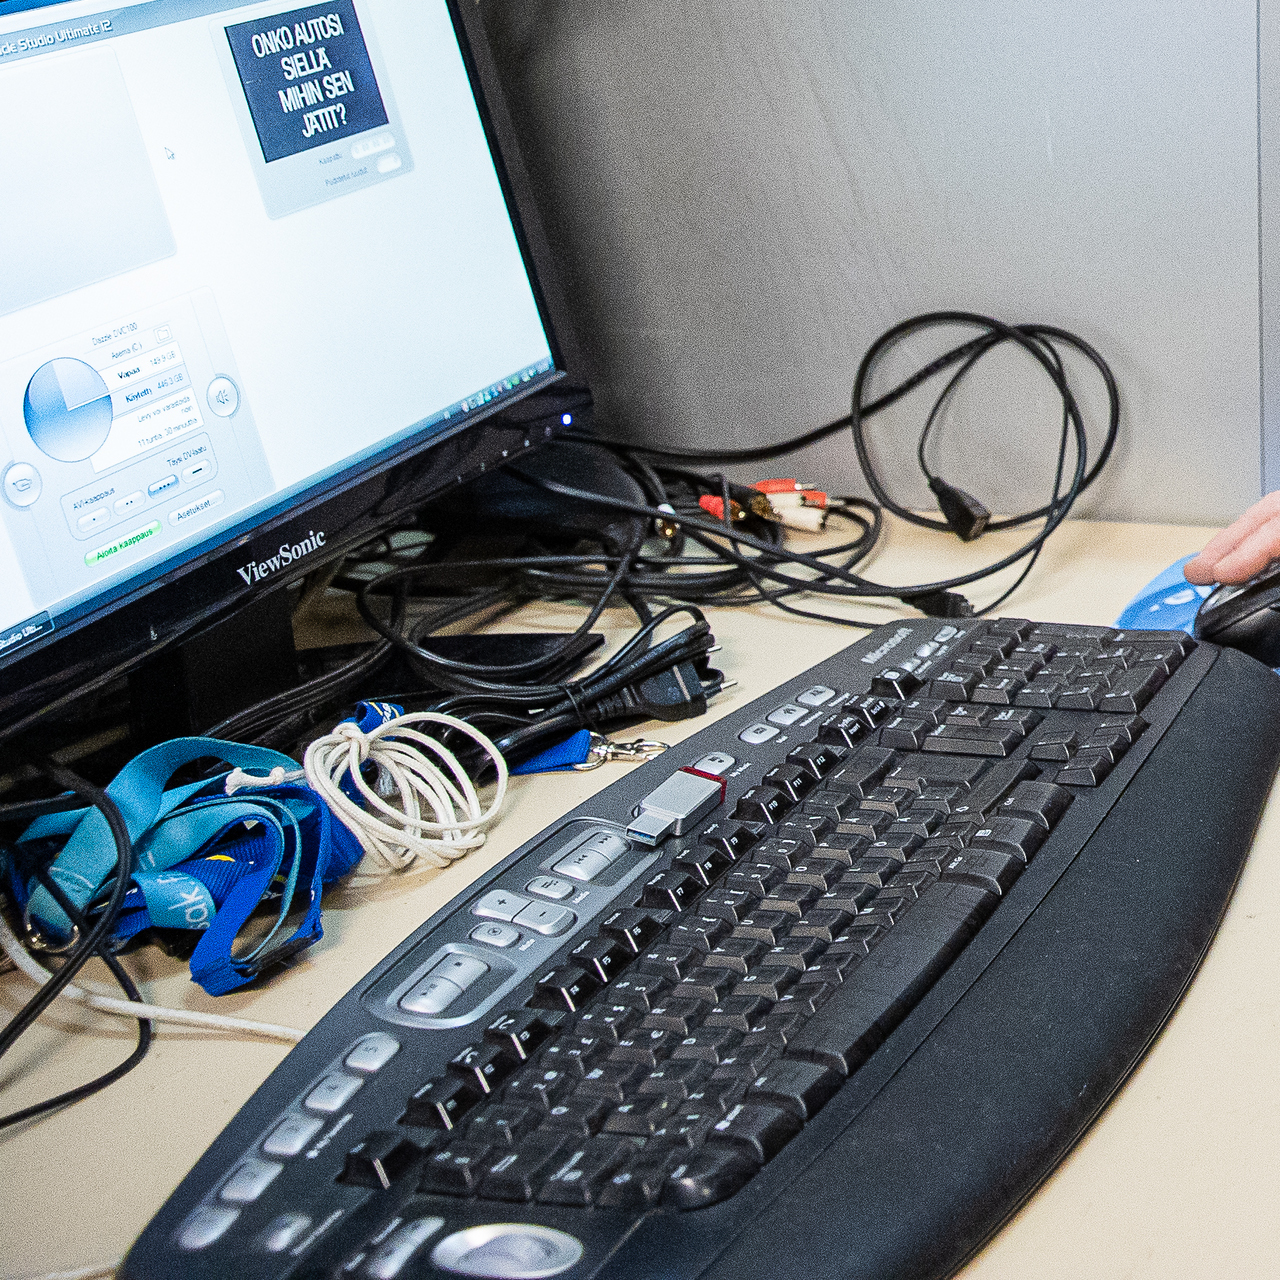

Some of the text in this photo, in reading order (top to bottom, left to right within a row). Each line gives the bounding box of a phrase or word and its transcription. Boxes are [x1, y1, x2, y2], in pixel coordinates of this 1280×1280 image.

[17, 33, 55, 53] Studio
[54, 21, 100, 45] Ultimate
[99, 18, 113, 32] 12
[251, 12, 344, 59] ONKO AUTOSI
[281, 46, 333, 82] SIELLÄ
[277, 70, 355, 115] MIHIN SEN
[301, 103, 348, 139] JÄTIT?
[117, 366, 141, 380] Vapaa
[117, 527, 154, 550] kaappaus
[236, 528, 327, 586] ViewSonic
[602, 955, 612, 966] F5
